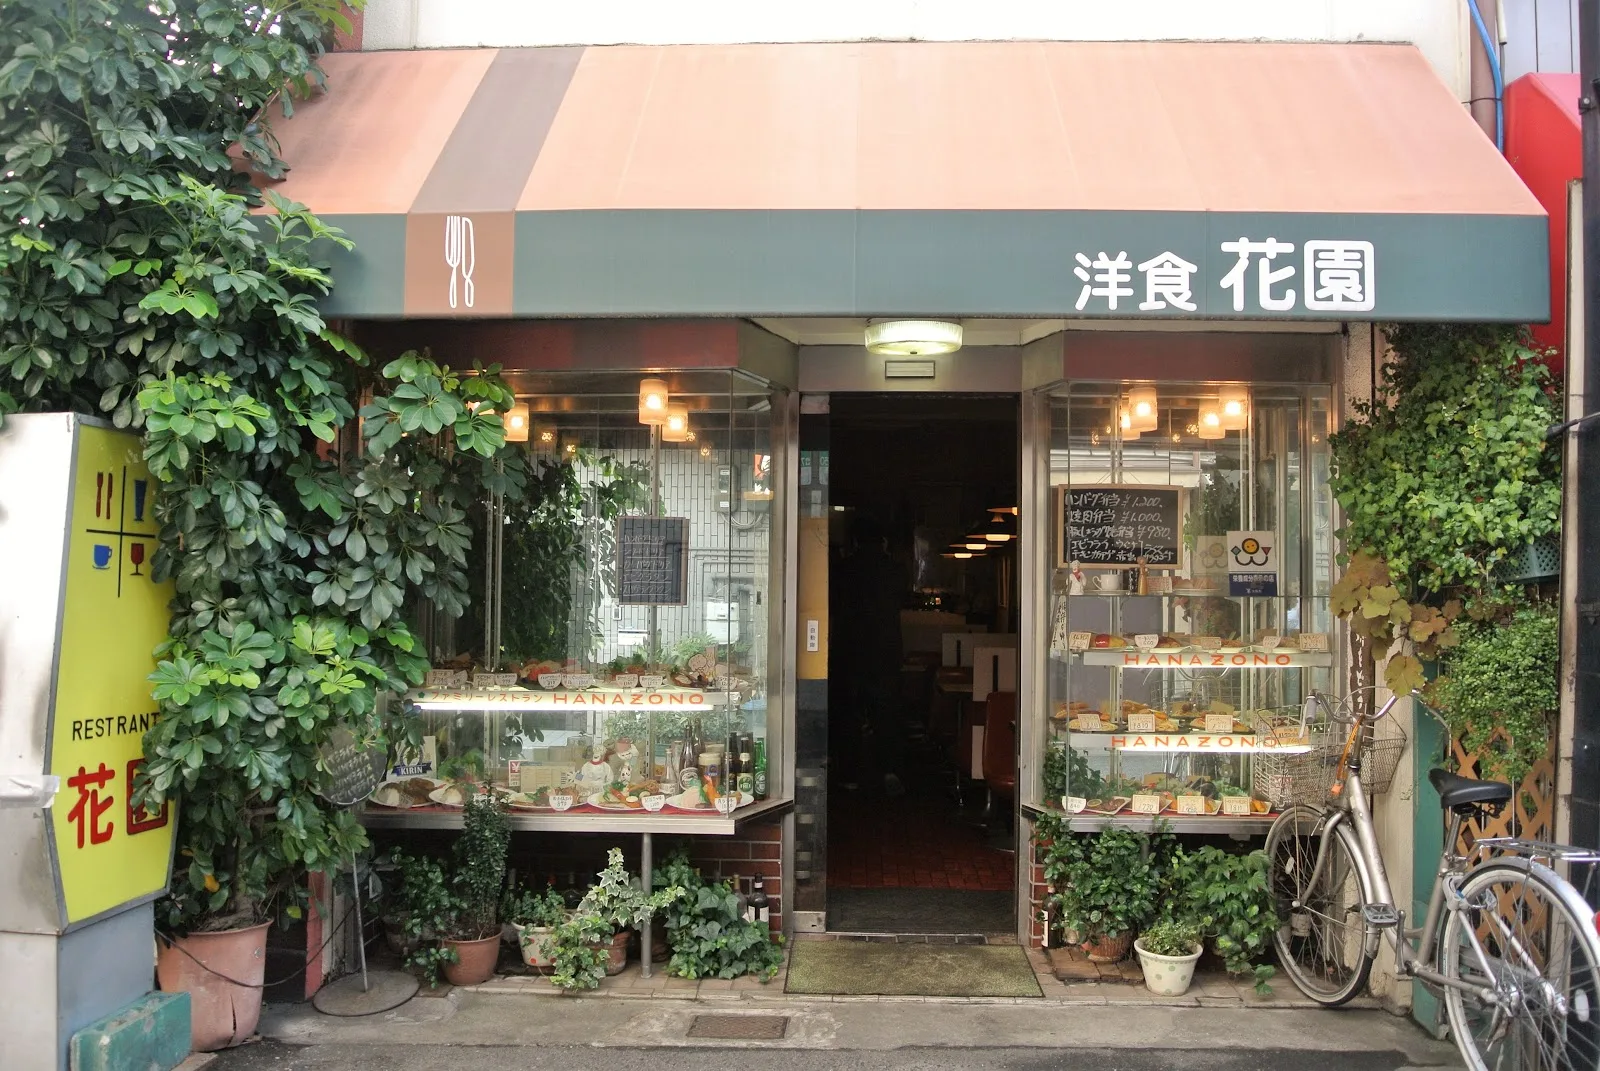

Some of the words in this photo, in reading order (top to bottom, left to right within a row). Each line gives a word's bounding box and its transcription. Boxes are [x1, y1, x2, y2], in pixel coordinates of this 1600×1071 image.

[1073, 250, 1198, 312] 洋食
[1219, 236, 1376, 312] 花園
[1124, 653, 1291, 666] HANAZONO
[432, 691, 543, 702] ファミリーレストラン
[553, 693, 704, 705] HANAZONO
[1111, 735, 1279, 748] HANAZONO
[400, 766, 423, 775] KIRIN
